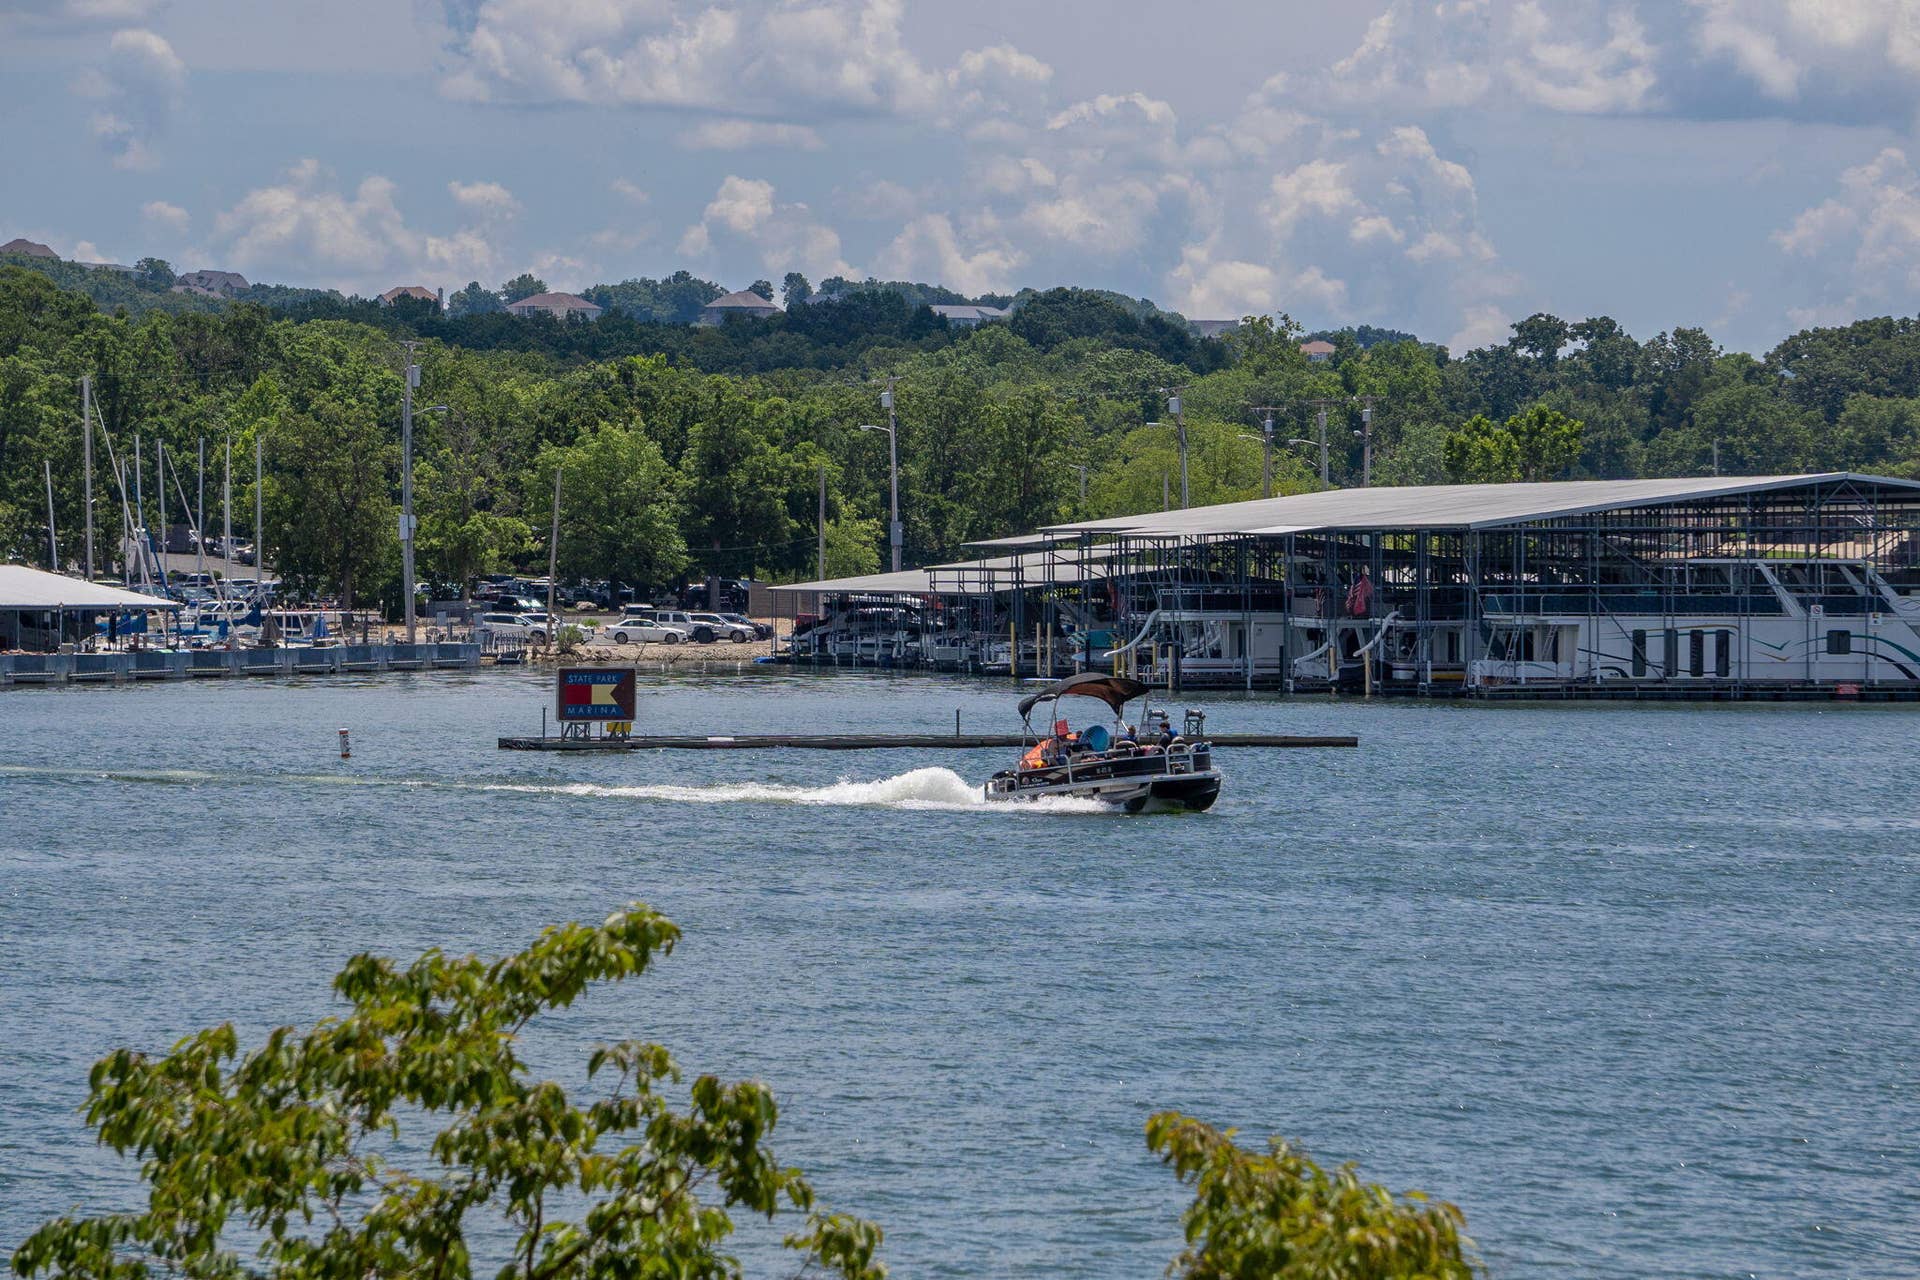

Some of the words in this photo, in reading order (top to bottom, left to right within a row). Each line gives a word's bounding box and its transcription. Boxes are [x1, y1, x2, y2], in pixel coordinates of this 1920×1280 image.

[568, 674, 592, 684] STATE
[596, 674, 618, 683] PARK
[567, 706, 617, 714] MARINA
